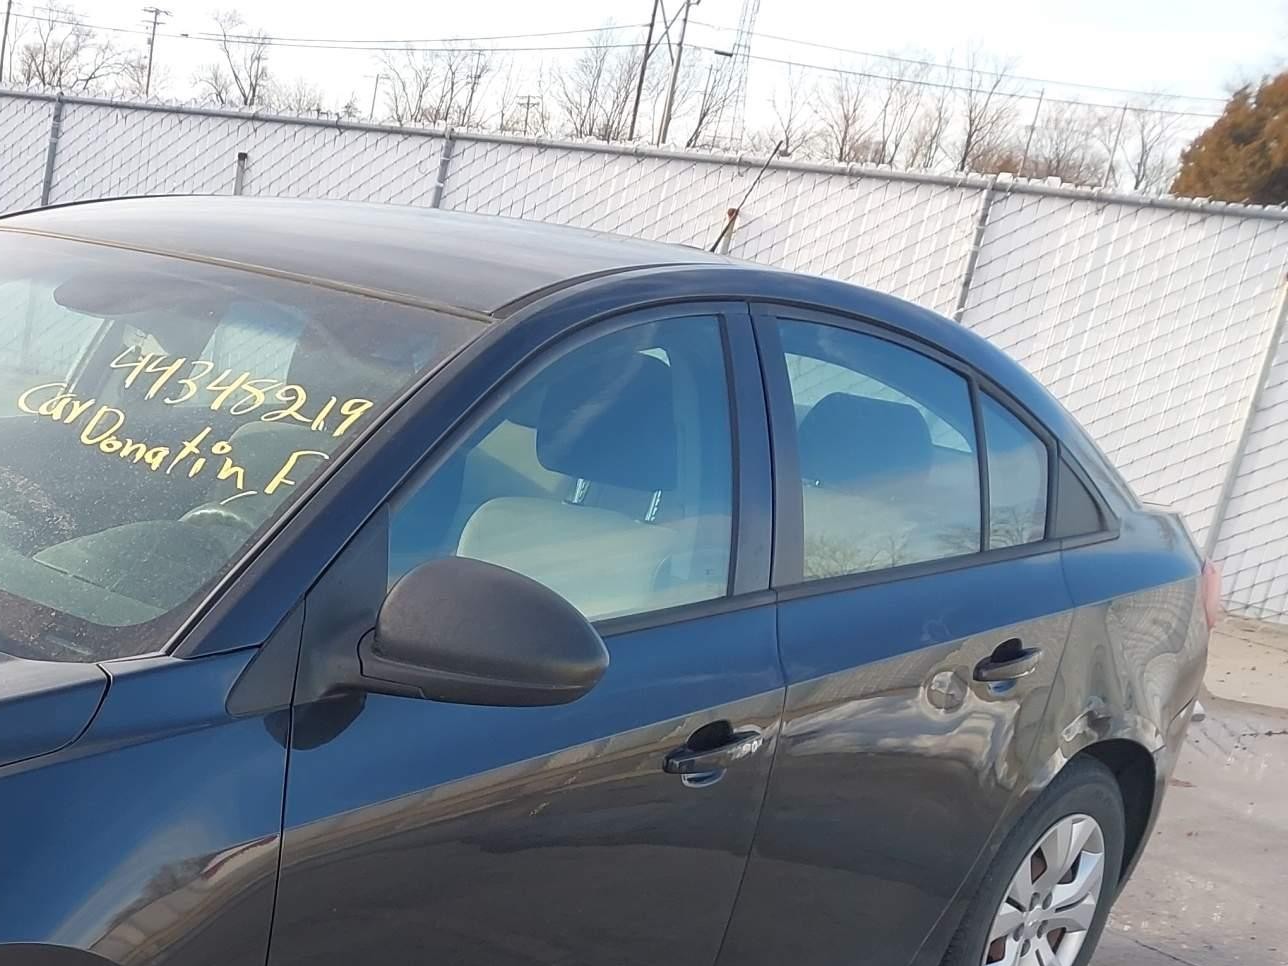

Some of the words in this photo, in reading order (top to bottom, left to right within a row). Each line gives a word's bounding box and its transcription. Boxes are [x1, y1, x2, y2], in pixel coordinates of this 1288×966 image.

[17, 382, 96, 424] Car
[264, 450, 329, 494] F
[110, 345, 374, 437] 44348219
